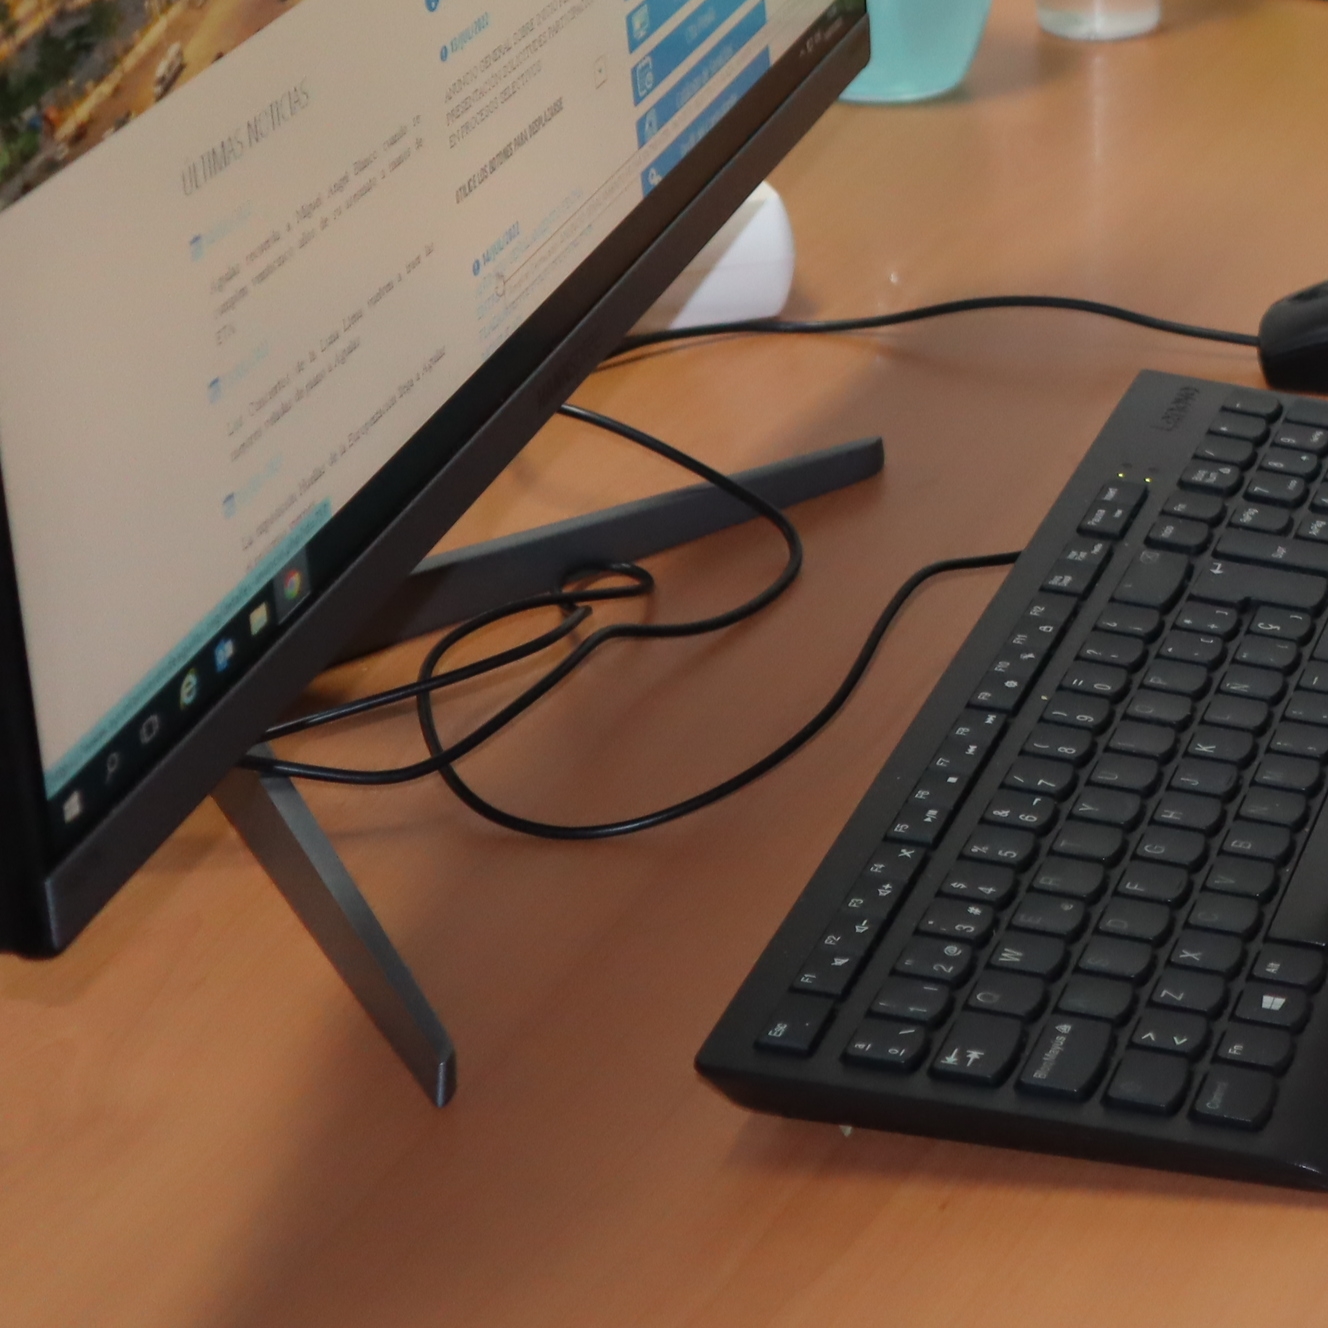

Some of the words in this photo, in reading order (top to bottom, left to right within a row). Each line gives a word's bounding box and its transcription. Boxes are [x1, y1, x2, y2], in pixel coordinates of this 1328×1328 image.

[1028, 604, 1046, 616] F12
[1074, 713, 1096, 723] 9
[1056, 745, 1078, 755] 8
[1194, 742, 1216, 753] K
[934, 757, 951, 767] F7
[1036, 778, 1057, 788] 7
[1179, 776, 1200, 786] J
[1016, 812, 1039, 822] 6
[892, 822, 910, 833] F5
[996, 848, 1018, 859] 5
[1142, 843, 1166, 855] G
[868, 862, 886, 872] F4
[976, 884, 997, 895] 4
[847, 896, 864, 908] F3
[953, 922, 976, 933] 3
[823, 934, 842, 946] F2
[997, 946, 1024, 963] W
[1178, 948, 1203, 961] X
[931, 962, 954, 974] 2
[799, 972, 818, 984] F1
[1159, 987, 1186, 1001] Z
[766, 1021, 788, 1038] Esc
